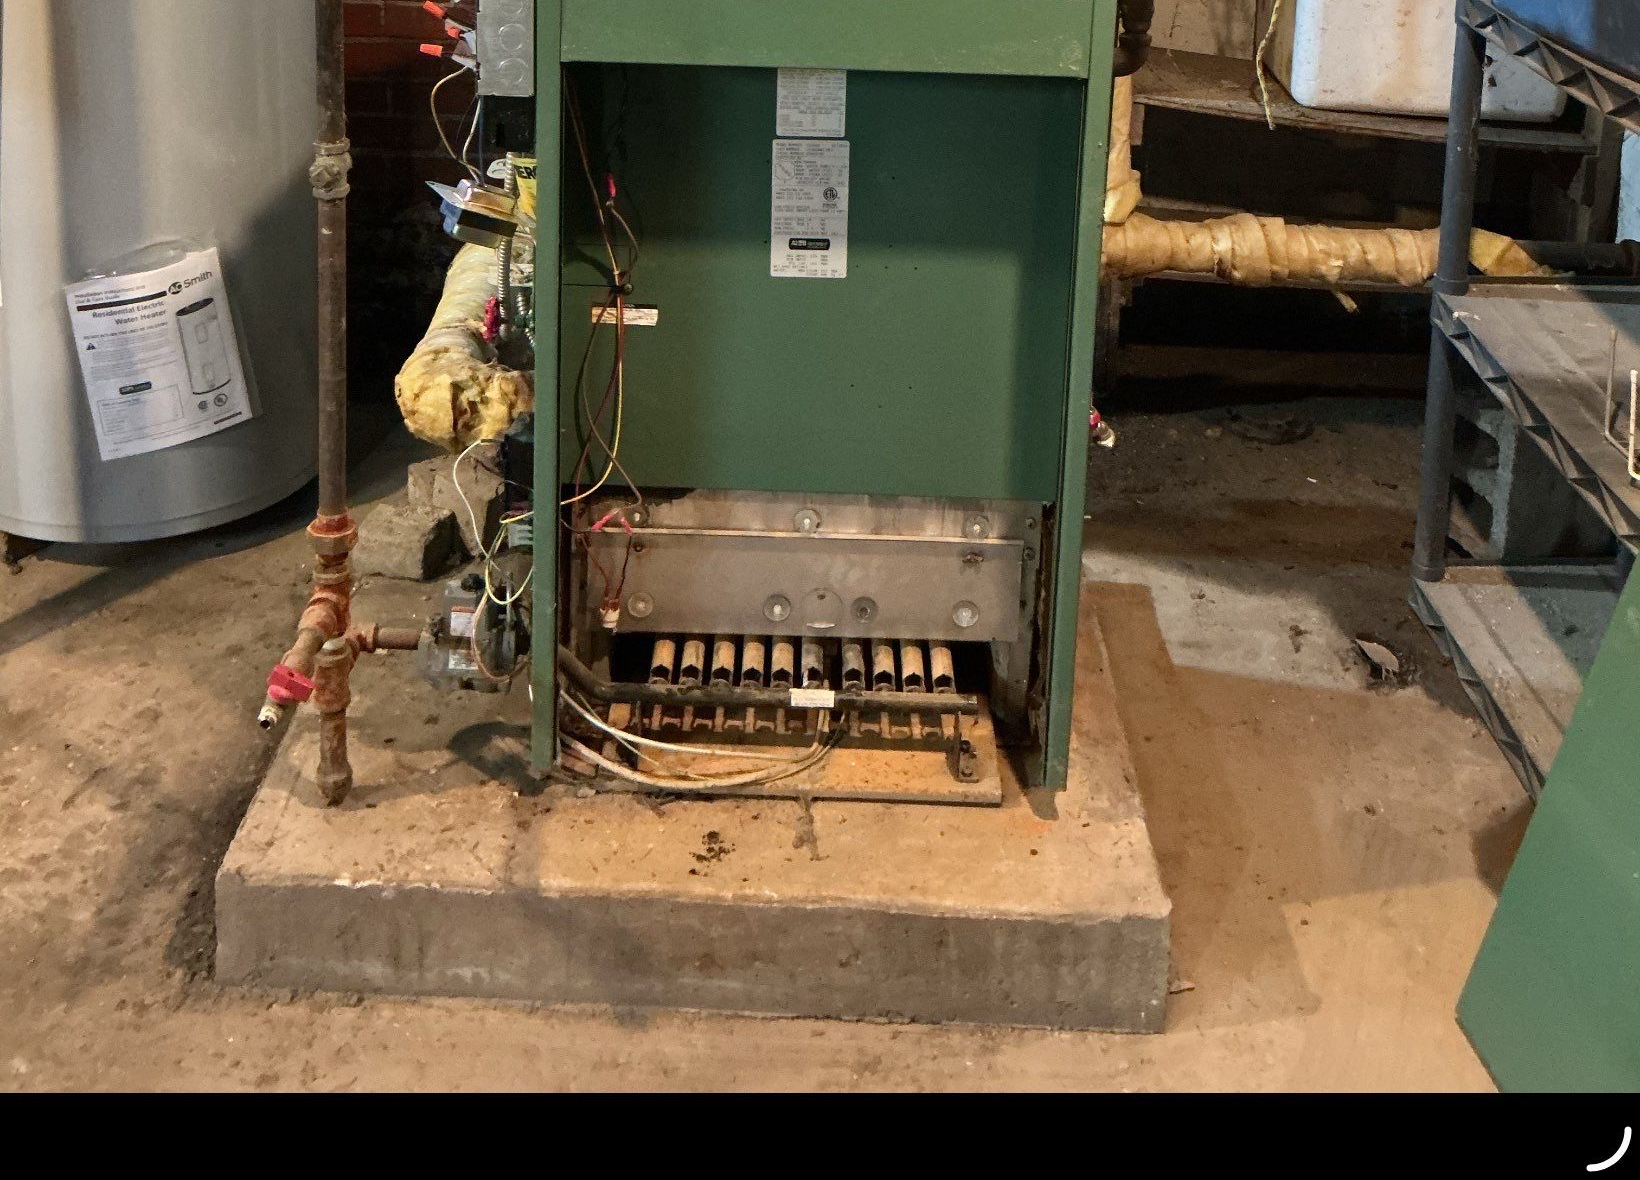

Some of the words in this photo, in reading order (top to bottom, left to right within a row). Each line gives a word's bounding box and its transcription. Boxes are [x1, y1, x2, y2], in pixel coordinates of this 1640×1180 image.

[183, 271, 213, 289] Smith
[92, 306, 135, 319] Residential
[137, 301, 165, 312] Electric
[114, 316, 138, 325] Water
[140, 309, 167, 320] Heater
